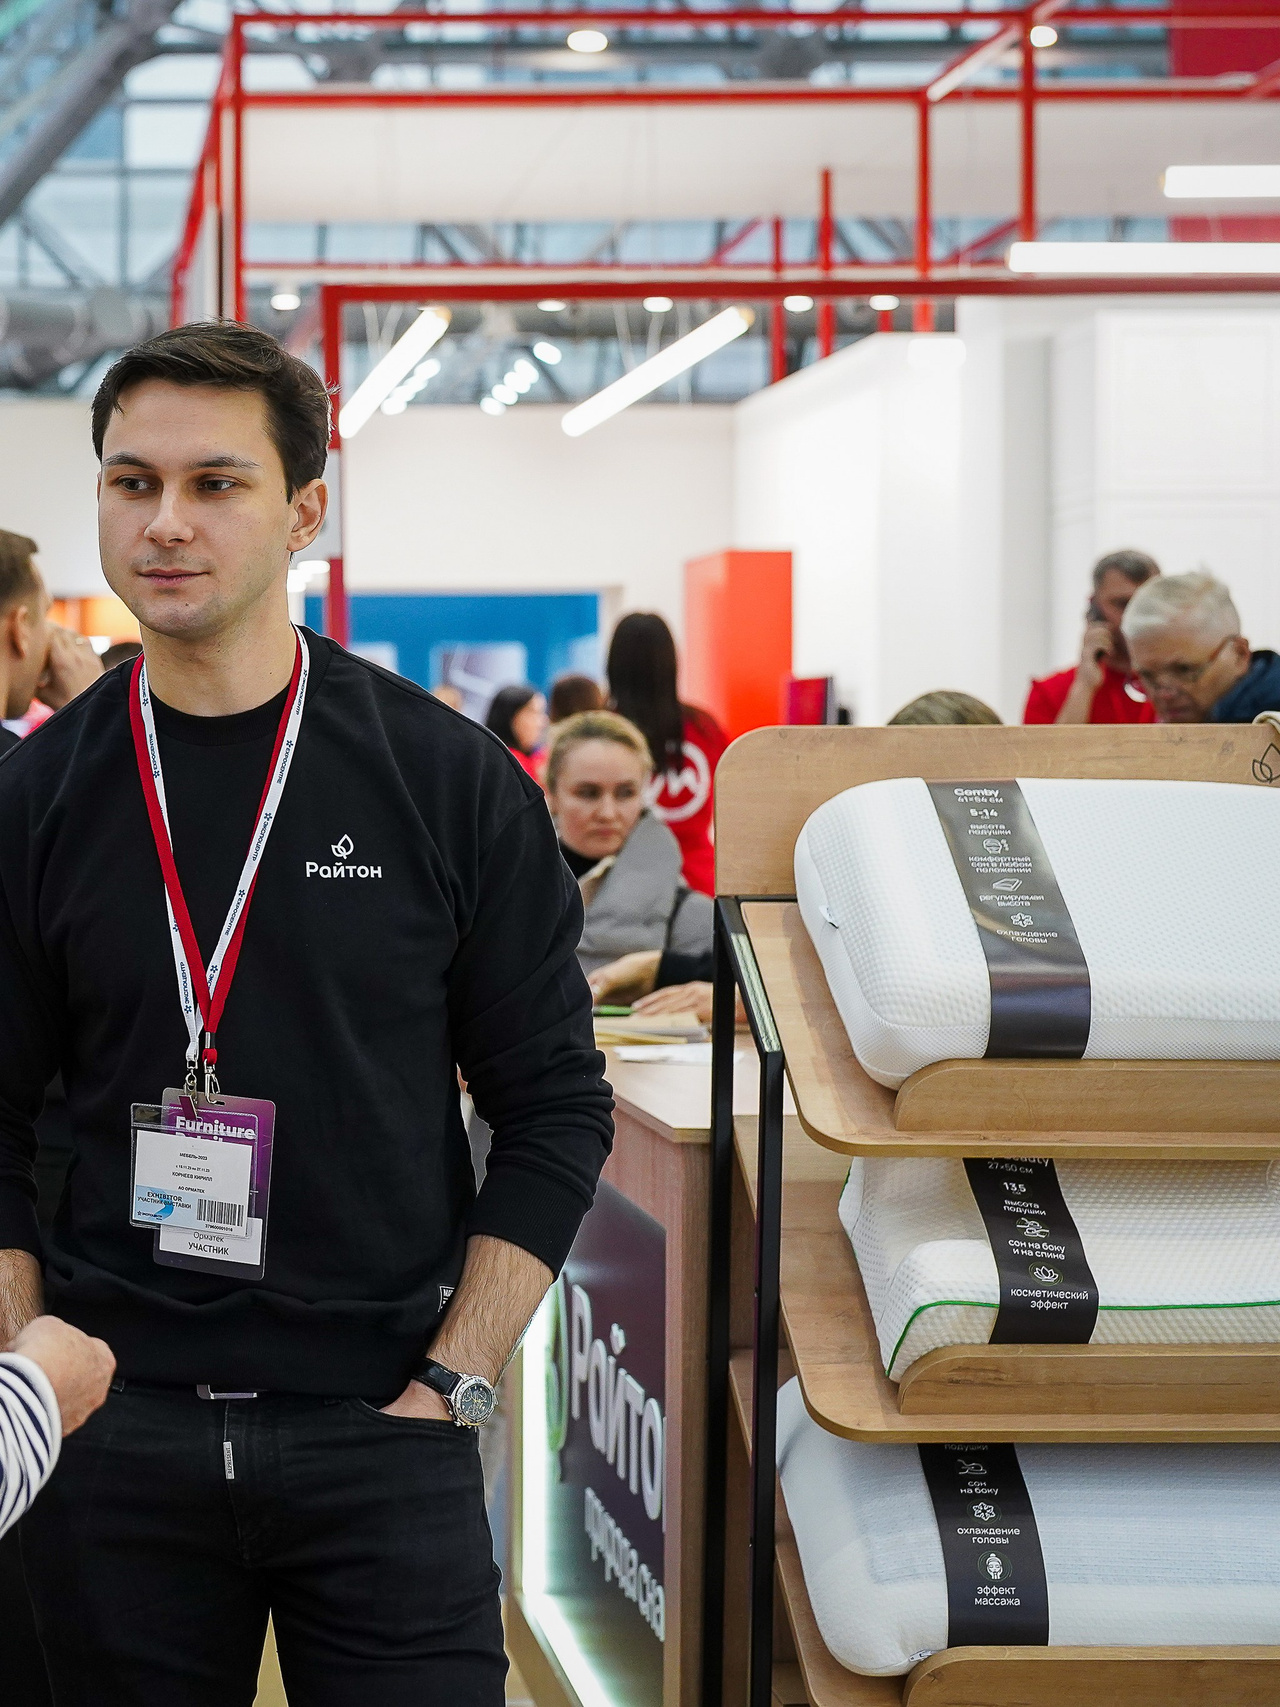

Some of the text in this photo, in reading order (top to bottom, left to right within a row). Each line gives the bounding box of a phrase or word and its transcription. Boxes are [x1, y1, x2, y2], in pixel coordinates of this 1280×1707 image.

[968, 855, 1031, 863] комфортный
[305, 861, 383, 879] Райтон
[996, 929, 1058, 938] охлаждение
[1011, 936, 1048, 944] головы
[175, 1115, 257, 1140] Furniture
[147, 1191, 183, 1202] EXHIBITOR
[1004, 1199, 1040, 1209] высота
[1003, 1205, 1047, 1216] подушки
[193, 1231, 225, 1243] Орматек
[188, 1242, 230, 1256] УЧАСТНИК
[1008, 1239, 1066, 1254] сон на боку
[1021, 1249, 1034, 1257] на
[1035, 1250, 1066, 1260] спине
[1010, 1287, 1090, 1300] косметический
[1030, 1299, 1069, 1311] эффект
[974, 1487, 999, 1496] боку
[956, 1527, 1021, 1536] охлаждение
[972, 1536, 1010, 1545] головы
[976, 1585, 1017, 1597] эффект
[974, 1597, 1021, 1606] массажа
